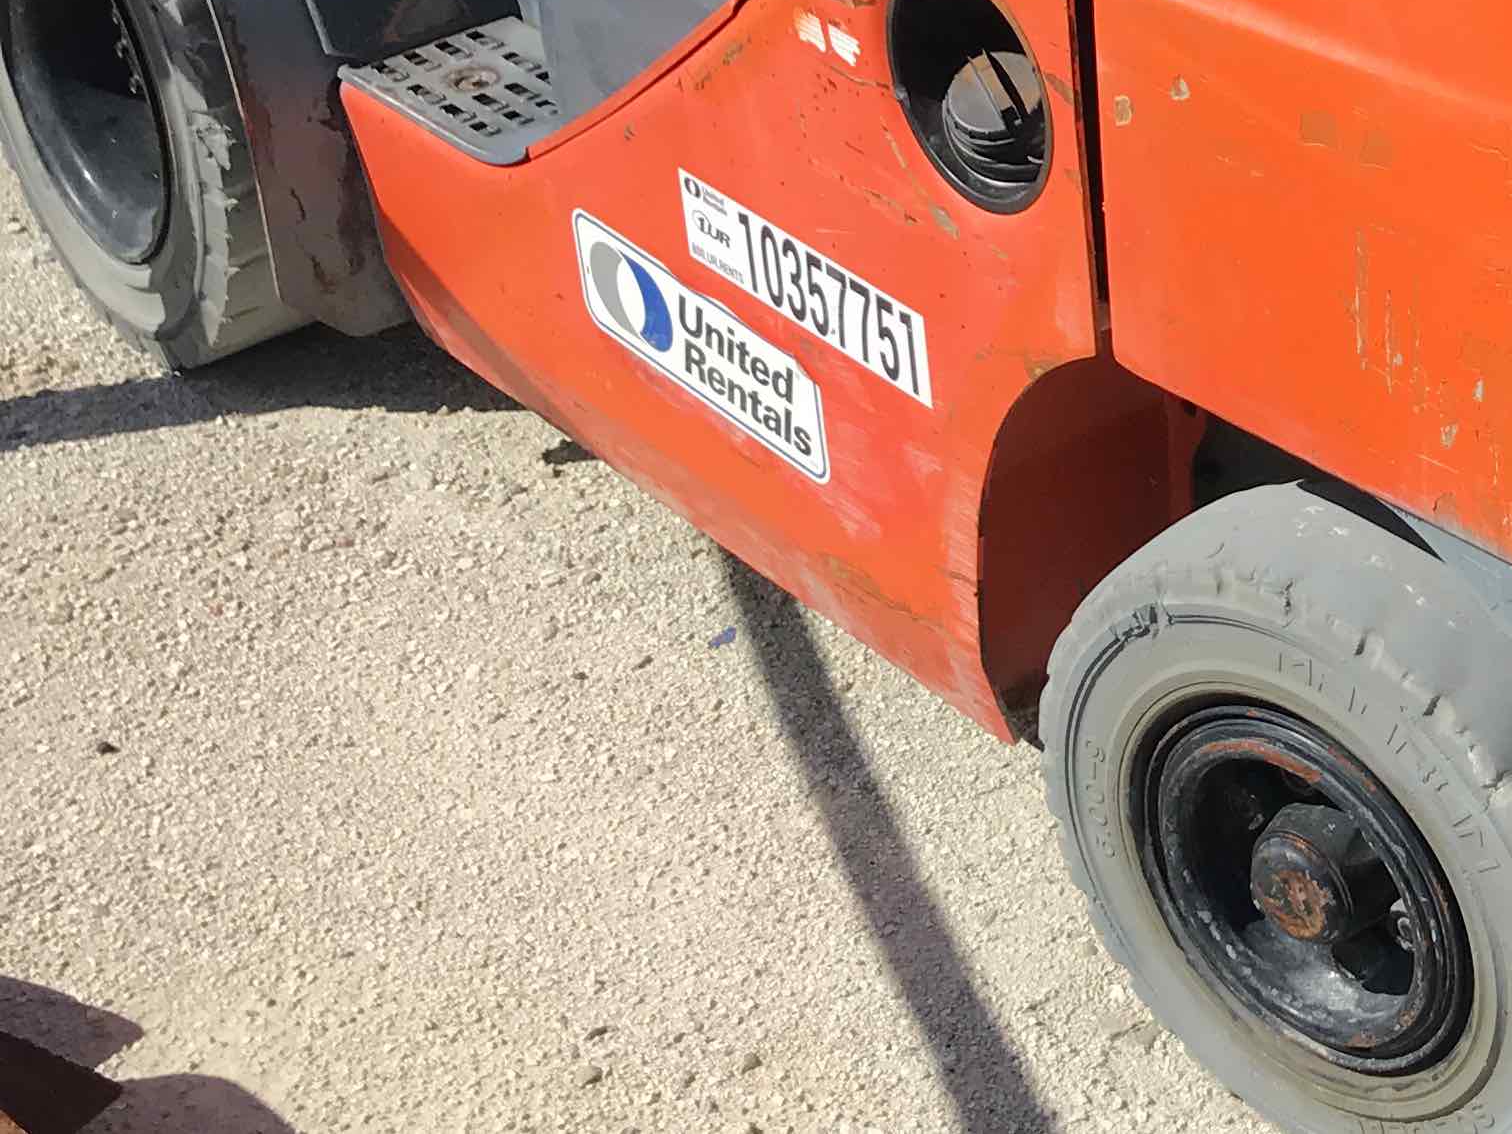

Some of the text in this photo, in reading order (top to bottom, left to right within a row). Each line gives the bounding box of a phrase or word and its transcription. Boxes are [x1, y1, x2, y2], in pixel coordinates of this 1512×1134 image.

[678, 293, 794, 404] United
[738, 211, 920, 395] 10357751
[684, 338, 812, 457] Rentals
